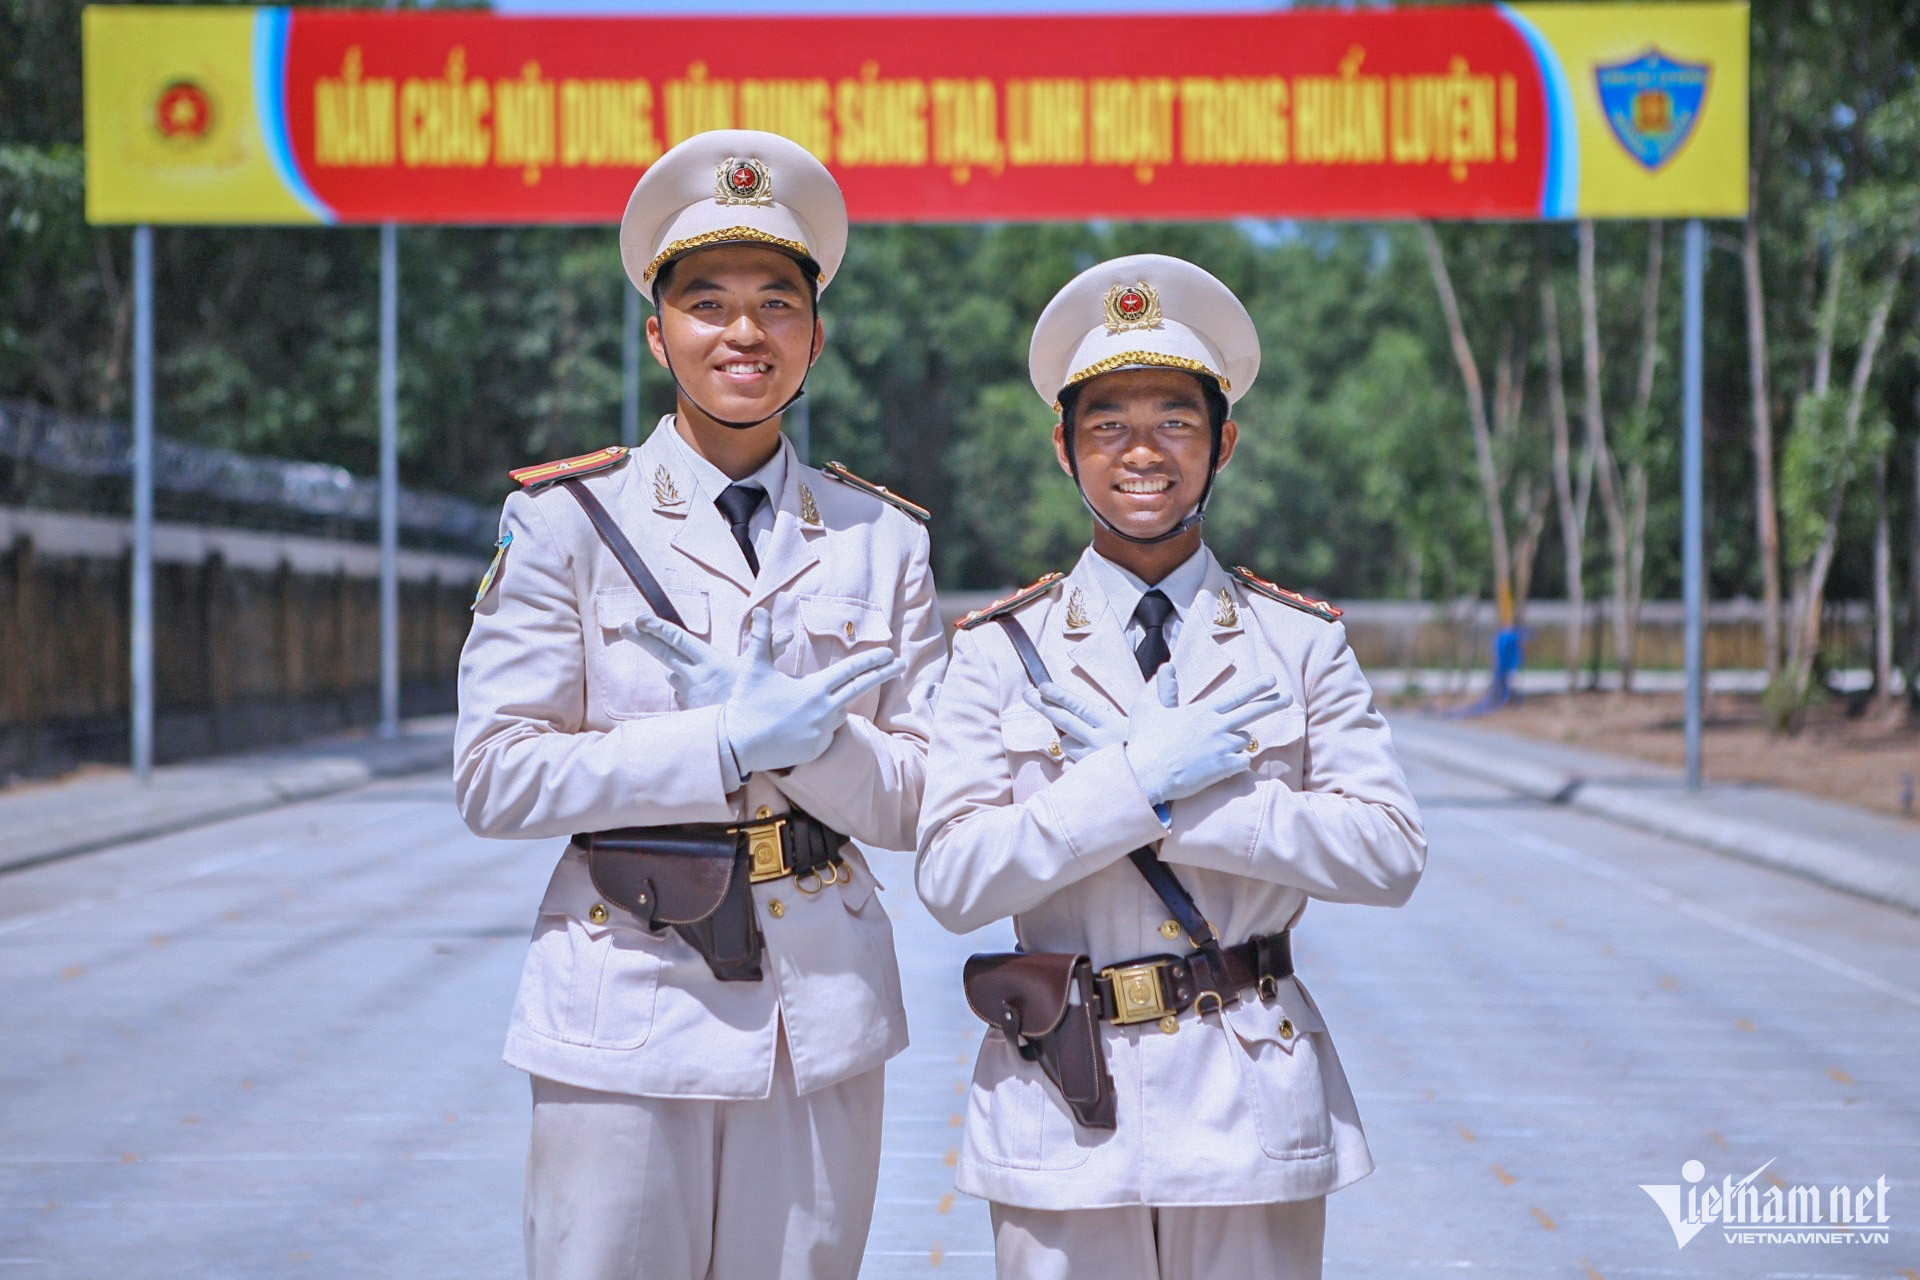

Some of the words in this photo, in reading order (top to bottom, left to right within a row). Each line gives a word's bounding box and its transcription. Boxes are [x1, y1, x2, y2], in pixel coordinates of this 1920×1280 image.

[314, 45, 397, 166] NẮM
[402, 46, 491, 167] CHẮC
[494, 60, 556, 186] NỘI
[835, 60, 929, 166] SÁNG
[1006, 78, 1088, 164] LINH
[1089, 78, 1175, 184] HOẠT
[1180, 77, 1290, 164] TRONG
[1293, 45, 1386, 164] HUẤN
[1389, 55, 1496, 182] LUYỆN
